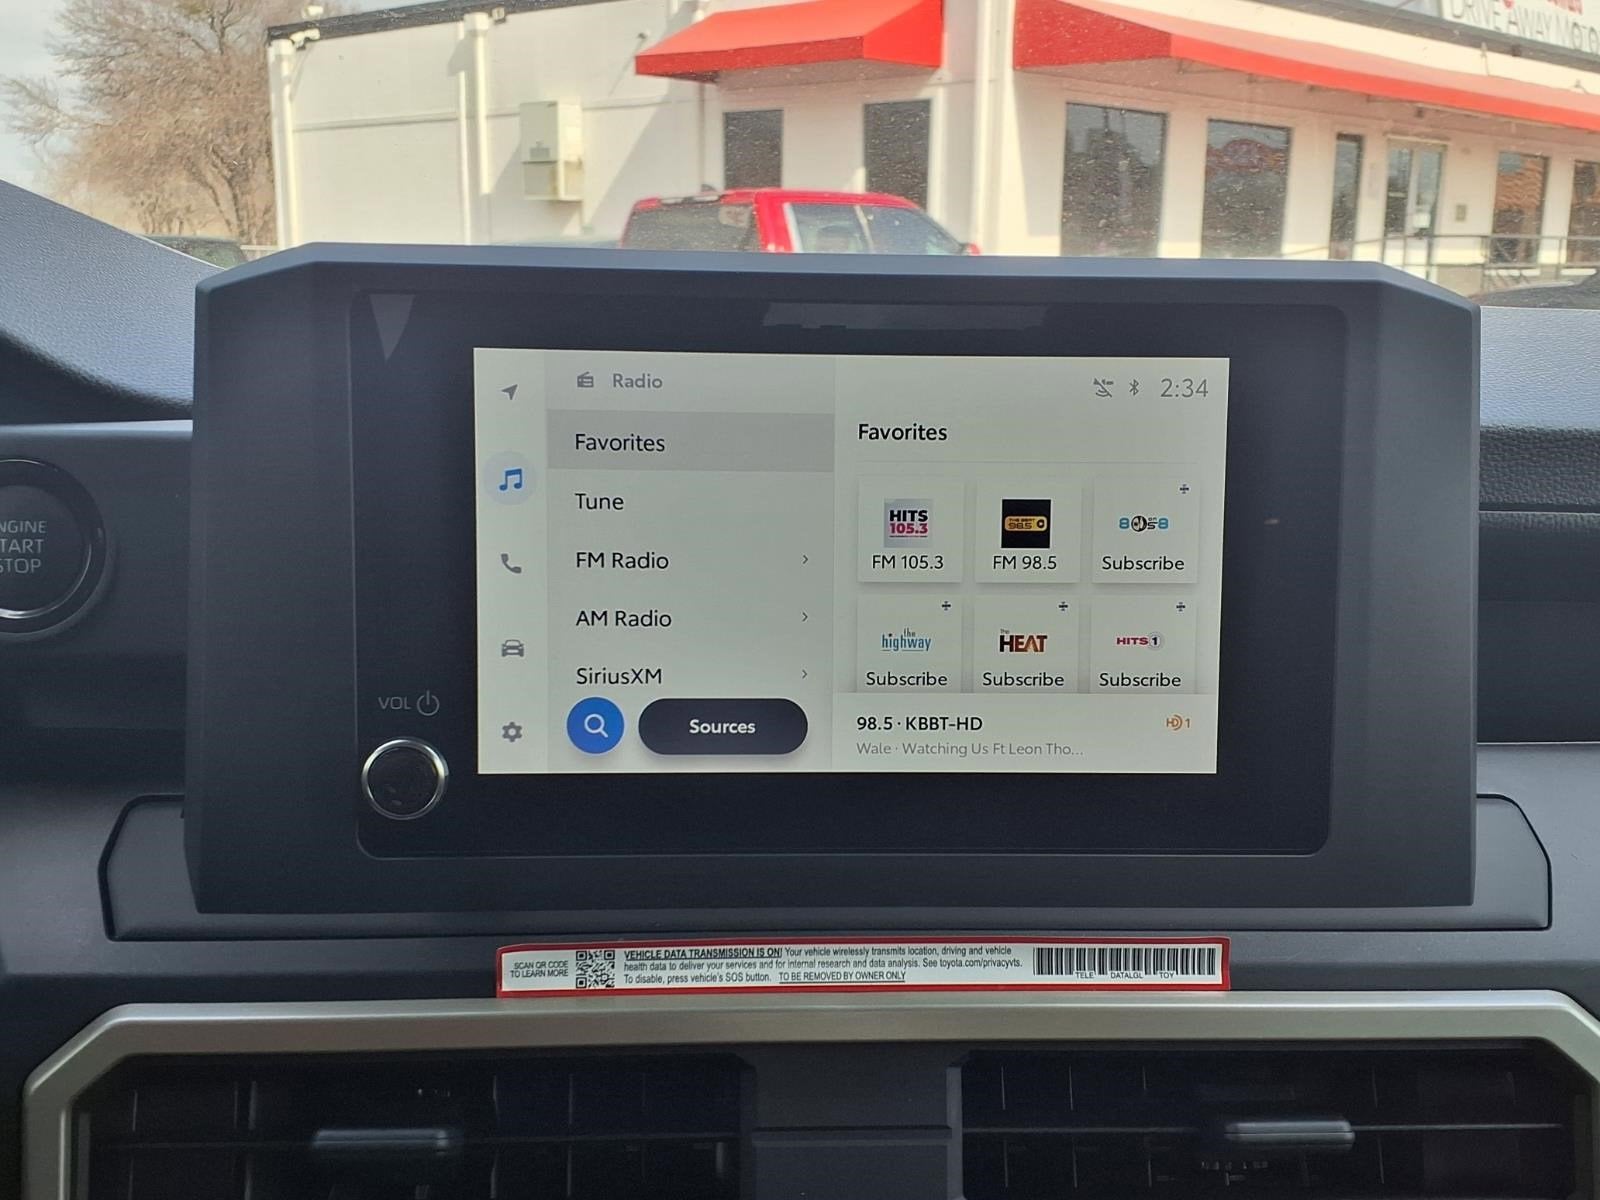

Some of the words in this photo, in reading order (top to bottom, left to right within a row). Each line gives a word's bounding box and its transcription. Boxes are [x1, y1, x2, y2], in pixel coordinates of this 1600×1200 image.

[1507, 6, 1552, 42] AWAY
[612, 373, 663, 389] Radio
[1161, 378, 1208, 397] 2:34
[858, 423, 948, 441] Favorites
[575, 434, 665, 452] Favorites
[575, 493, 624, 511] Tune
[889, 509, 928, 522] HITS
[0, 520, 47, 534] NGINE
[890, 523, 928, 534] 105.3
[0, 538, 44, 553] TART
[576, 552, 605, 569] FM
[611, 551, 669, 569] Radio
[872, 555, 896, 569] FM
[901, 555, 944, 569] 105.3
[993, 555, 1016, 570] FM
[1022, 555, 1057, 570] 98.5
[1102, 555, 1185, 570] Subscribe
[575, 610, 608, 627] AM
[614, 609, 672, 627] Radio
[881, 633, 932, 652] highway
[999, 634, 1048, 653] HEAT
[1116, 637, 1149, 645] HITS
[576, 667, 662, 685] SiriusXM
[866, 671, 948, 686] Subscribe
[982, 671, 1065, 686] Subscribe
[1099, 672, 1182, 687] Subscribe
[378, 696, 412, 710] VOL
[689, 718, 756, 734] Sources
[856, 716, 893, 731] 98.5
[905, 716, 983, 731] KBBT-HD
[856, 742, 891, 755] Wale
[902, 742, 968, 758] Watching
[971, 743, 989, 755] Us
[993, 743, 1005, 755] Ft
[1009, 743, 1042, 755] Leon
[624, 950, 662, 960] VEHICLE
[664, 949, 687, 959] DATA
[689, 948, 754, 958] TRANSMISSION
[756, 948, 765, 957] IS
[785, 947, 802, 956] Your
[804, 947, 831, 956] vehicle
[832, 946, 869, 958] wirelessly
[871, 946, 906, 956] transmits
[907, 946, 939, 956] location,
[941, 946, 967, 957] driving
[968, 946, 983, 955] and
[985, 946, 1012, 955] vehicle
[514, 961, 534, 970] SCAN
[548, 960, 569, 968] CODE
[624, 961, 648, 972] health
[650, 961, 667, 971] data
[669, 961, 677, 971] to
[679, 960, 705, 971] deliver
[706, 962, 723, 973] your
[725, 960, 756, 970] services
[758, 959, 773, 969] and
[775, 959, 786, 969] for
[787, 959, 816, 969] internal
[817, 958, 850, 968] research
[852, 958, 867, 968] and
[868, 958, 886, 968] data
[888, 958, 921, 969] analysis.
[922, 957, 938, 967] See
[510, 970, 521, 978] TO
[522, 969, 546, 978] LEARN
[547, 968, 569, 977] MORE
[624, 974, 634, 984] To
[635, 973, 665, 985] disable,
[667, 974, 688, 986] press
[690, 972, 723, 983] vehicle's
[725, 972, 743, 982] SOS
[745, 972, 772, 982] button.
[779, 972, 790, 981] TO
[791, 972, 802, 981] BE
[803, 971, 841, 981] REMOVED
[843, 971, 853, 980] BY
[854, 971, 885, 980] OWNER
[886, 971, 906, 980] ONLY
[1075, 971, 1094, 979] TELE
[1159, 971, 1174, 979] TOY
